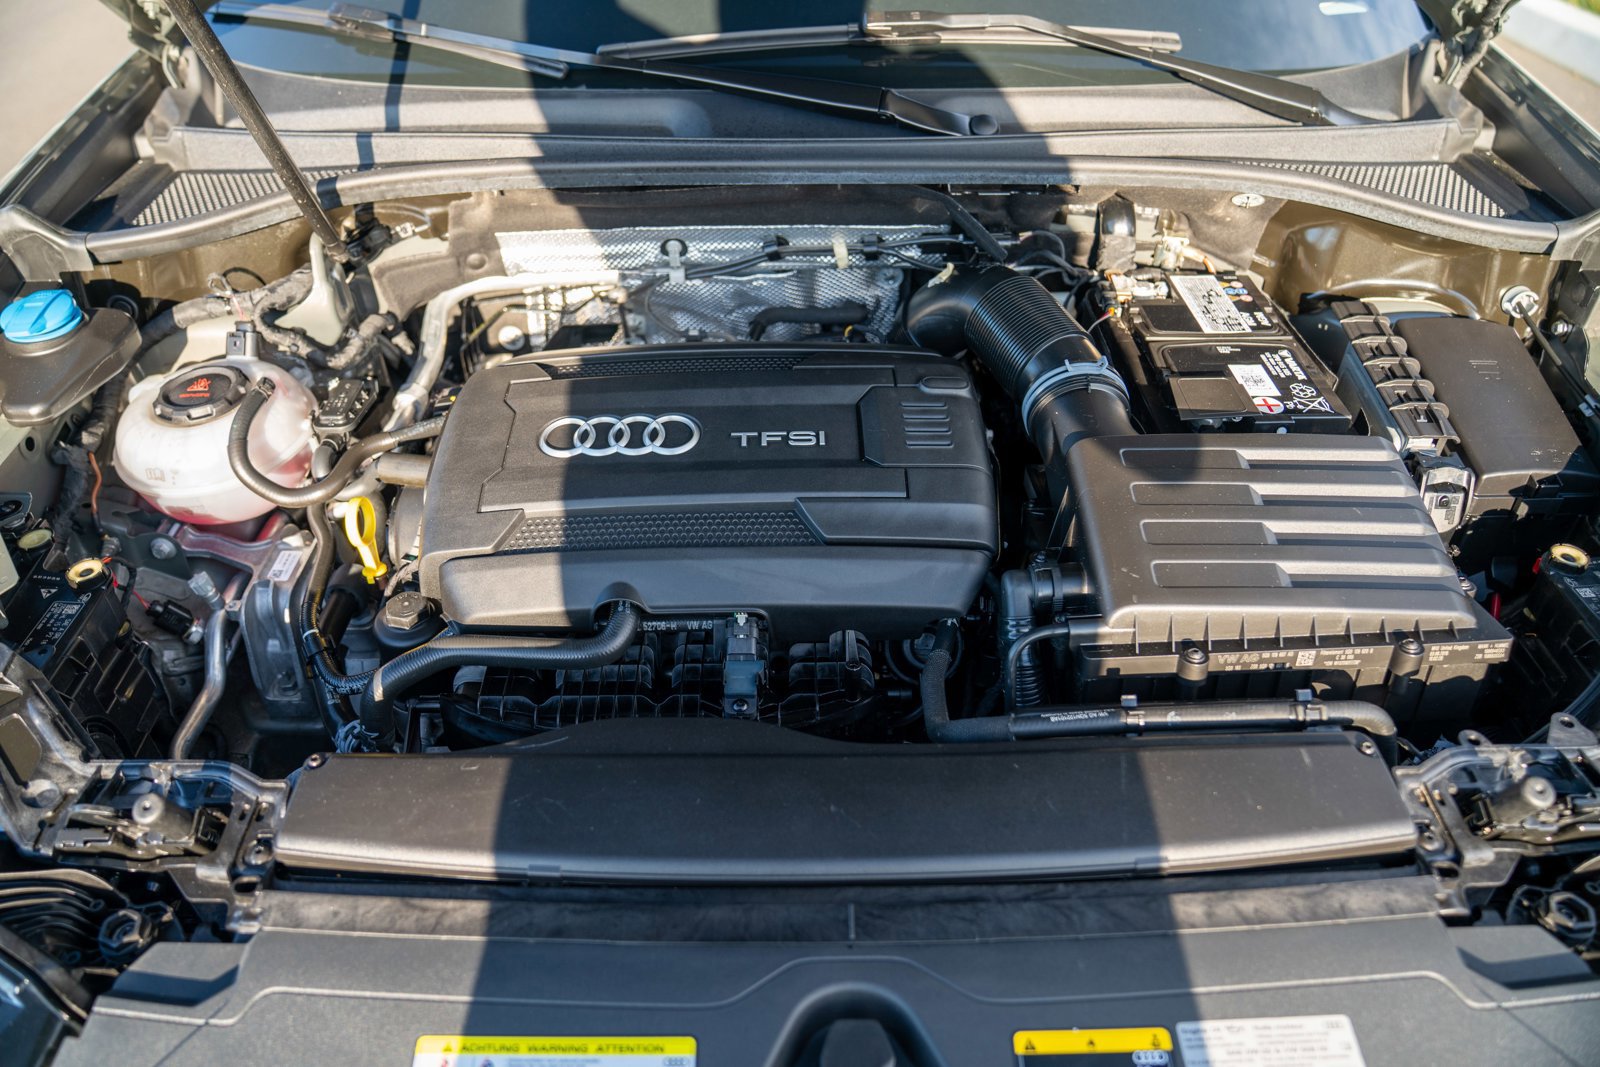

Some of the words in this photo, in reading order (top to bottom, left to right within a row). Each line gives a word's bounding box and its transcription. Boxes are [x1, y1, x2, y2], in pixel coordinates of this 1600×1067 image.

[1284, 357, 1307, 380] VARTA
[1284, 401, 1295, 410] Pb
[731, 430, 825, 447] TFSI
[686, 621, 699, 630] VW
[701, 620, 713, 630] AG
[1217, 654, 1239, 664] VW
[1240, 653, 1260, 663] AG
[460, 1042, 520, 1054] ACHTUNG
[527, 1043, 589, 1054] WARNING
[597, 1042, 665, 1054] ATTENTION
